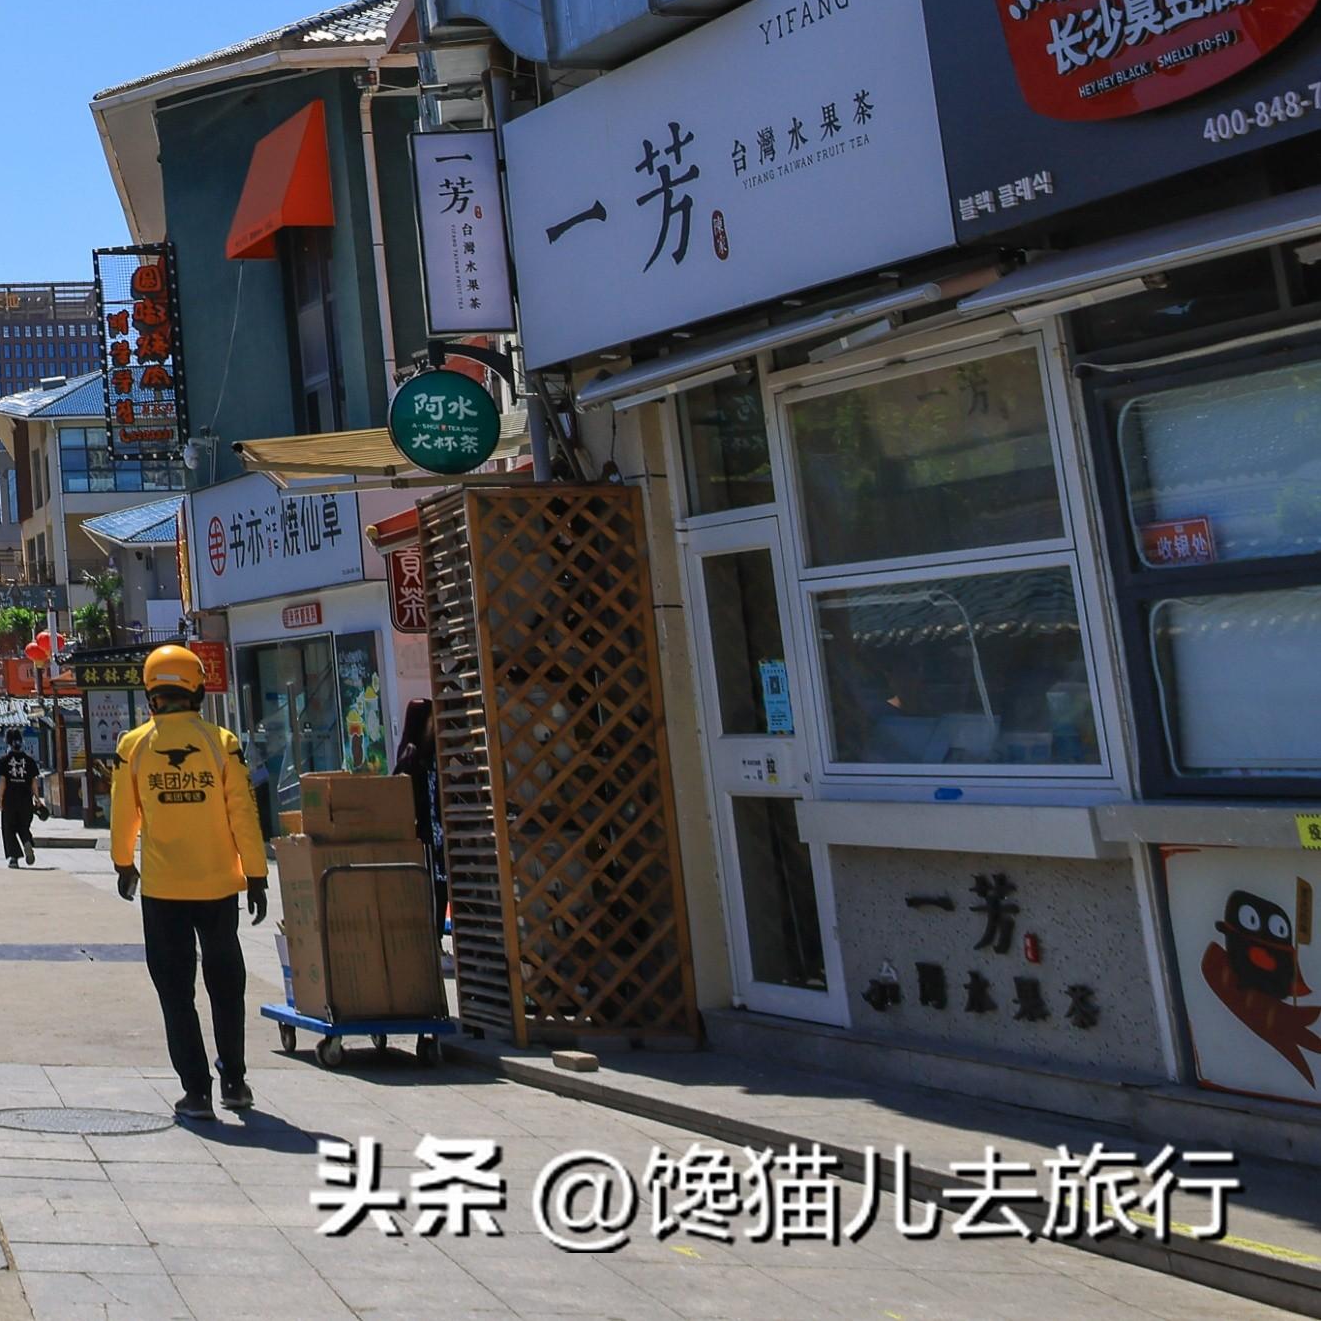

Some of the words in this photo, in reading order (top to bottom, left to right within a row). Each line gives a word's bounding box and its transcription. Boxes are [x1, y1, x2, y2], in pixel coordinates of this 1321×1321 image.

[1115, 62, 1148, 84] BLACK
[731, 88, 875, 177] 台灣水果茶
[434, 152, 475, 215] 一芳
[742, 169, 775, 190] YIFANG
[777, 154, 814, 177] TAIWAN
[816, 142, 846, 163] FRUIT
[849, 133, 870, 151] TEA
[546, 121, 700, 274] 一芳
[958, 189, 996, 221] 블랙
[413, 393, 478, 421] 阿水
[411, 433, 479, 454] 大杯茶
[230, 509, 264, 569] 书亦
[1157, 532, 1208, 561] 收银处
[148, 770, 215, 791] 美团外卖
[905, 872, 1020, 954] 一芳
